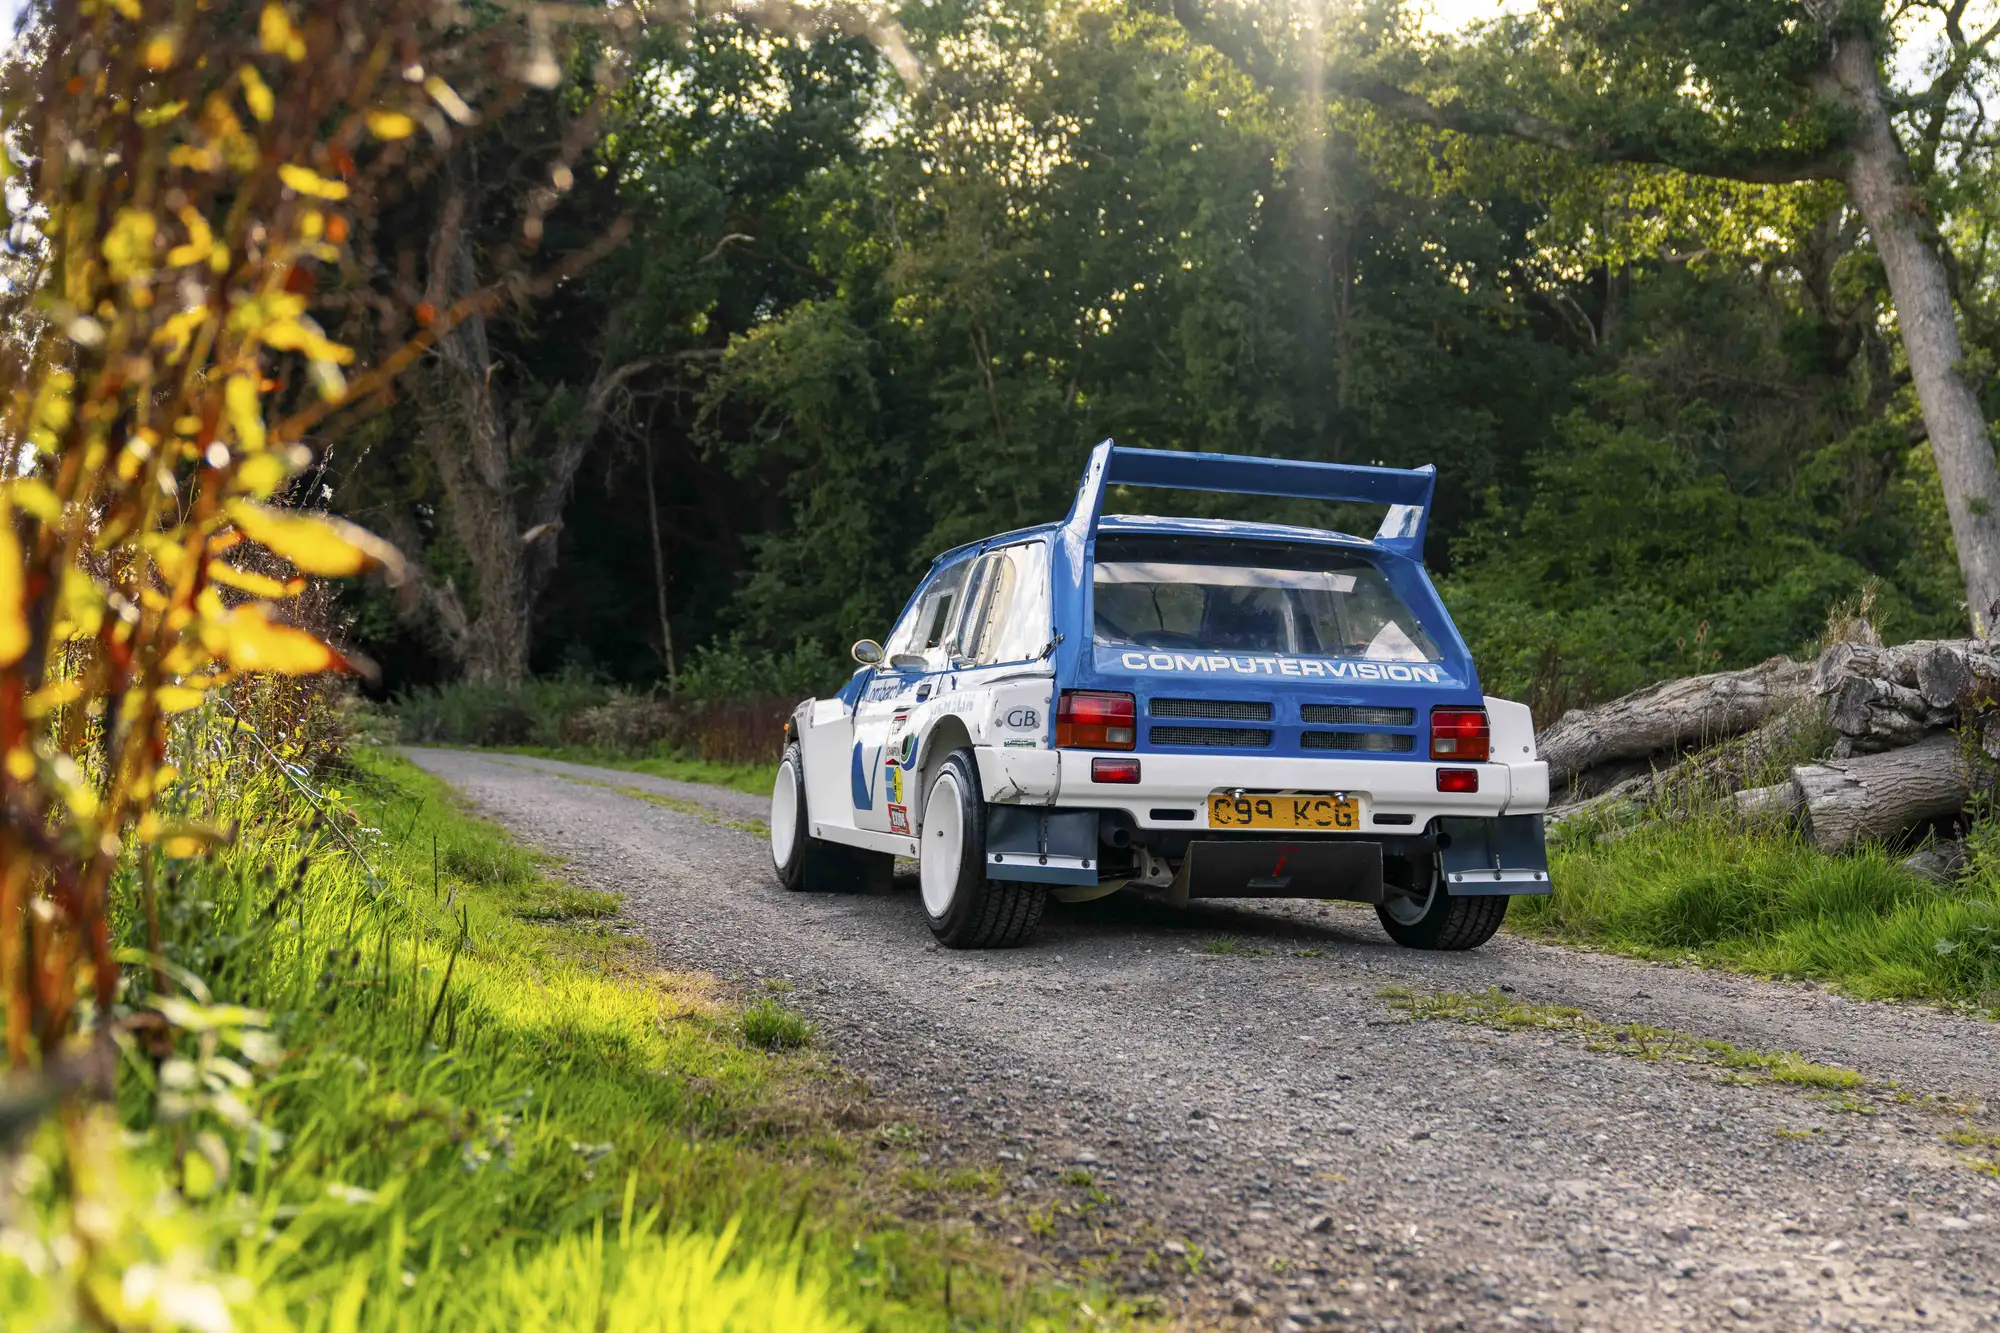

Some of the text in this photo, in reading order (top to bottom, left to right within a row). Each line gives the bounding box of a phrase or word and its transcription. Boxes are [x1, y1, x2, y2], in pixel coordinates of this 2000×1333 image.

[1121, 653, 1439, 683] COMPUTERVISION
[1007, 710, 1036, 727] GB
[1214, 799, 1352, 826] C99 KCG
